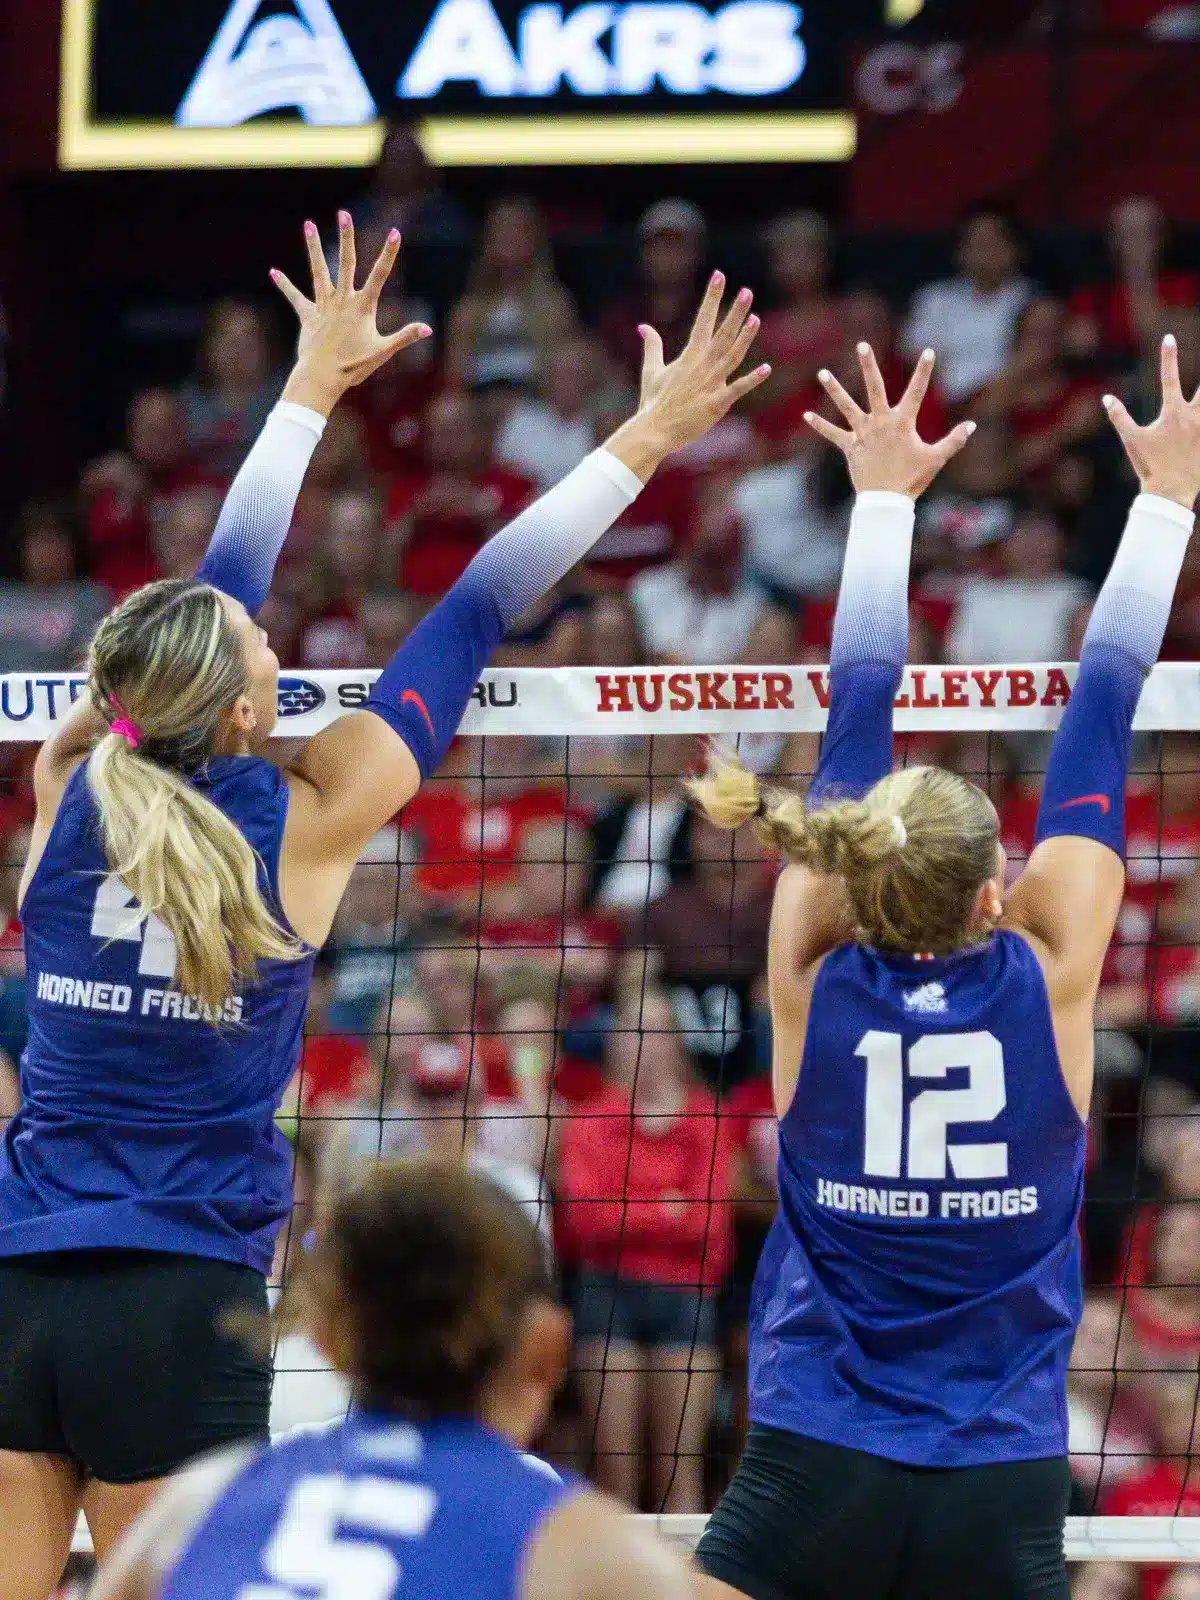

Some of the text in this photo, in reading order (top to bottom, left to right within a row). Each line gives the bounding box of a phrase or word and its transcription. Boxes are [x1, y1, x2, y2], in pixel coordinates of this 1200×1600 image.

[397, 0, 807, 98] AKRS
[337, 682, 518, 708] SRU
[595, 667, 1073, 713] HUSKER VLEYBA
[37, 971, 133, 1013] HORNED
[853, 1029, 1008, 1180] 12
[816, 1178, 1039, 1218] HORNED FROGS
[238, 1470, 438, 1600] 5
